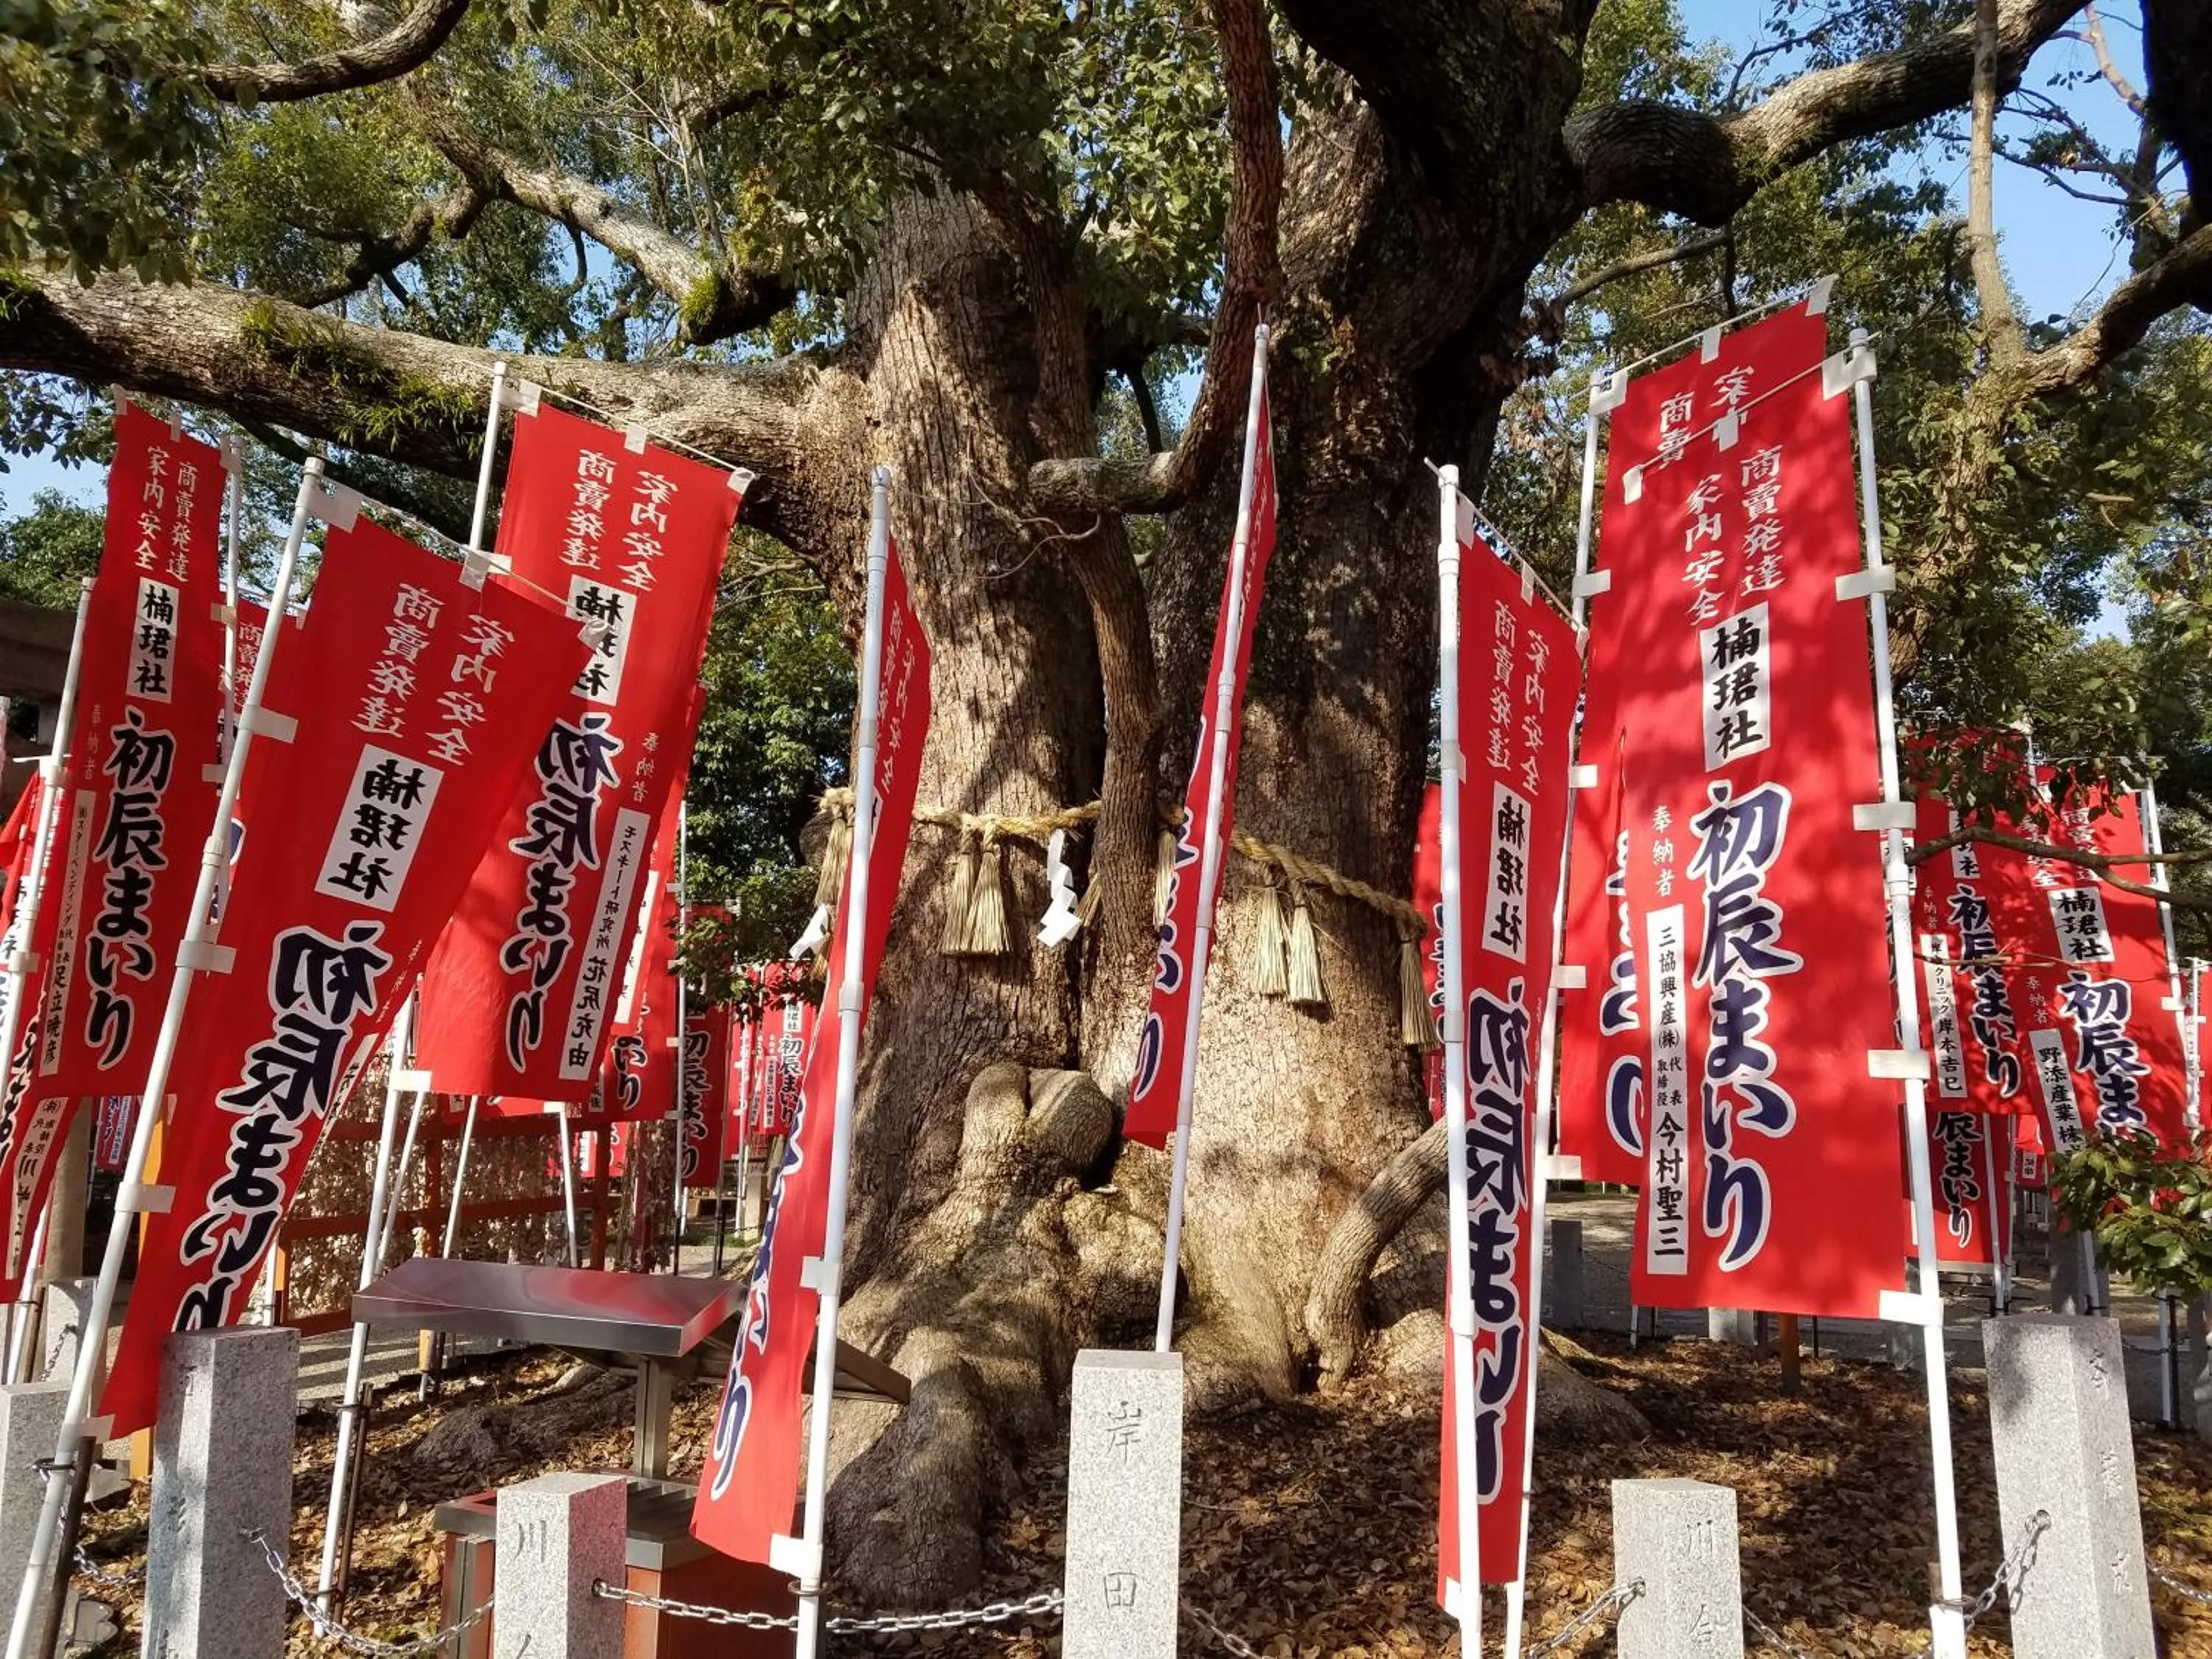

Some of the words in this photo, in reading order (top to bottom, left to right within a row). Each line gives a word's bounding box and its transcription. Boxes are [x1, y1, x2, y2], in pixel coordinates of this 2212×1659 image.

[134, 445, 170, 571] 家内安全
[166, 460, 200, 582] 商賣発達
[1681, 473, 1725, 627] 家内安全
[1739, 444, 1786, 598] 商賣発達
[85, 704, 178, 1071] 初辰まいり
[1652, 805, 1674, 897] 奉納者
[1688, 780, 1803, 1272] 初辰まいり
[1947, 884, 2021, 1097] 初辰まいり
[778, 1033, 804, 1127] 初辰まいり
[1654, 1111, 1686, 1256] 今村聖三
